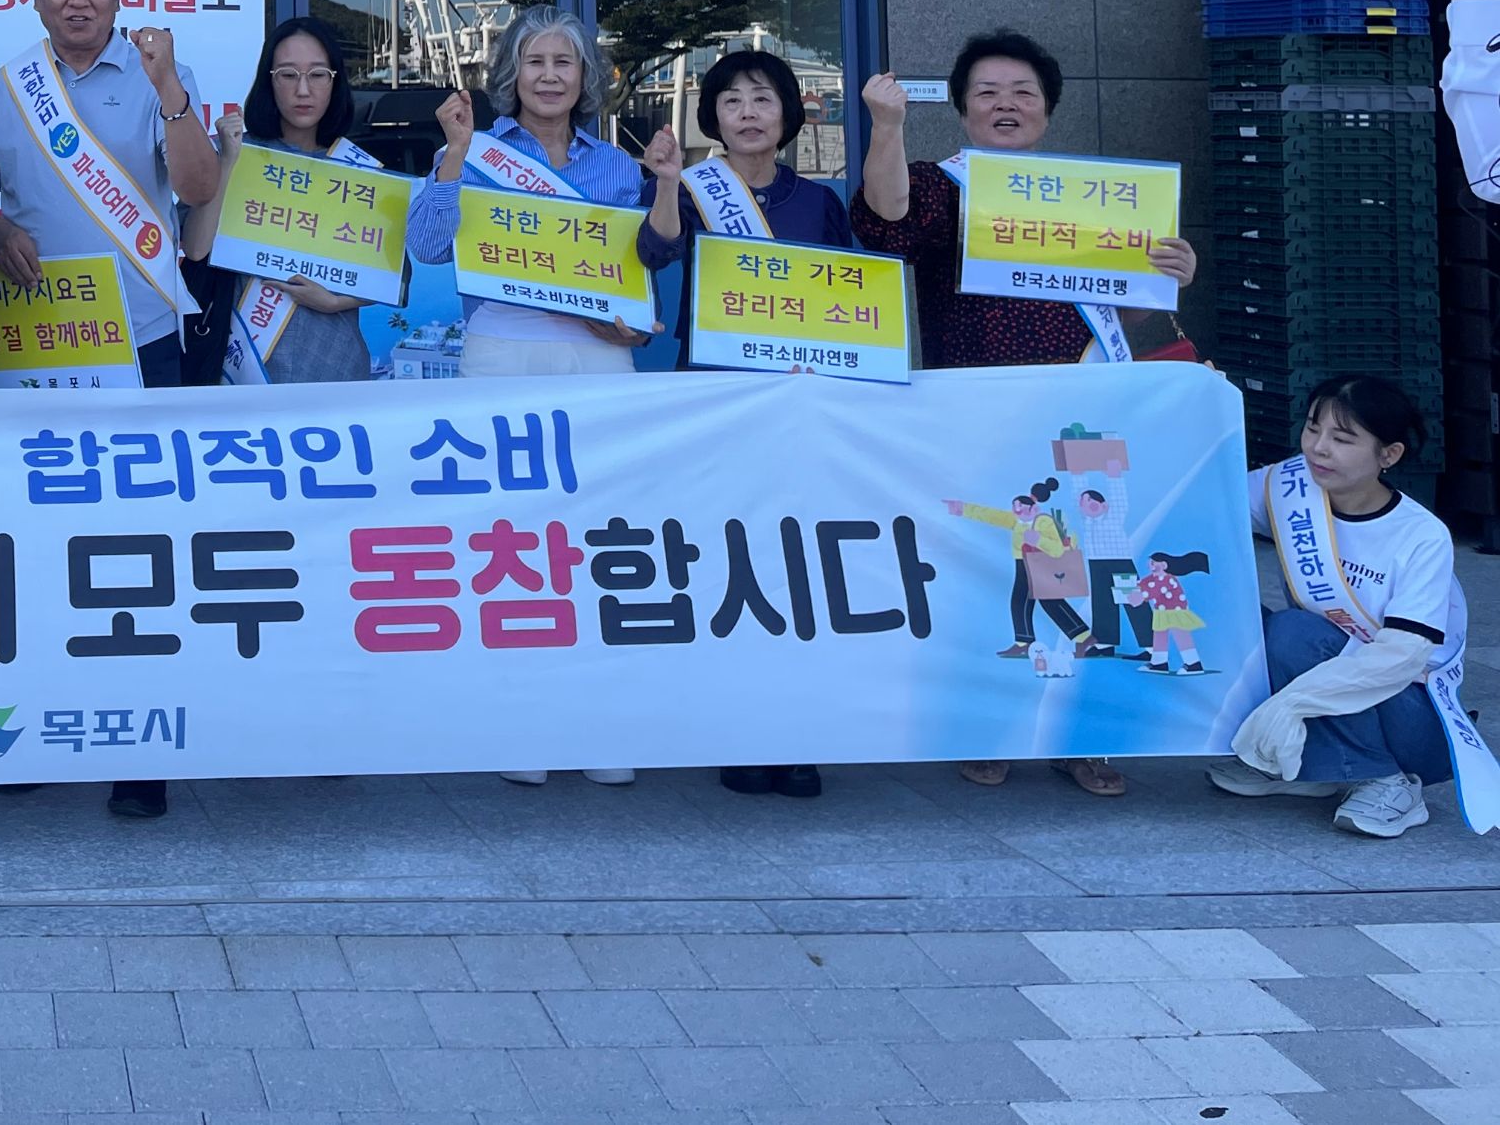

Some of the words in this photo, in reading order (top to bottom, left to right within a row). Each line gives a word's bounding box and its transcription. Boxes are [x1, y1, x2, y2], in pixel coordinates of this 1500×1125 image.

[17, 60, 60, 127] 착한소비
[52, 125, 78, 155] YES
[262, 162, 313, 195] 착한
[325, 177, 377, 209] 가격
[692, 165, 754, 236] 착한소비
[1008, 172, 1065, 204] 착한
[1082, 178, 1140, 210] 가격
[139, 227, 160, 255] NO
[244, 198, 320, 239] 합리적
[332, 220, 384, 253] 소비
[488, 206, 543, 237] 착한
[556, 215, 609, 247] 가격
[991, 216, 1080, 250] 합리적
[1094, 226, 1154, 257] 소비
[255, 250, 359, 288] 한국소비자연맹
[476, 241, 557, 275] 합리적
[572, 257, 624, 285] 소비
[735, 252, 792, 283] 착한
[808, 261, 866, 290] 가격
[1010, 269, 1129, 297] 한국소비자연맹
[501, 282, 611, 314] 한국소비자연맹
[720, 289, 807, 324] 합리적
[822, 298, 882, 331] 소비
[33, 319, 125, 351] 함께해요
[741, 340, 860, 370] 한국소비자연맹
[21, 421, 378, 506] 합리적인
[407, 406, 580, 496] 소비
[1287, 507, 1336, 603] 실천하는
[1338, 557, 1387, 585] rning
[64, 529, 306, 659] 모두
[348, 513, 937, 654] 동참합시다
[39, 705, 188, 754] 목포시
